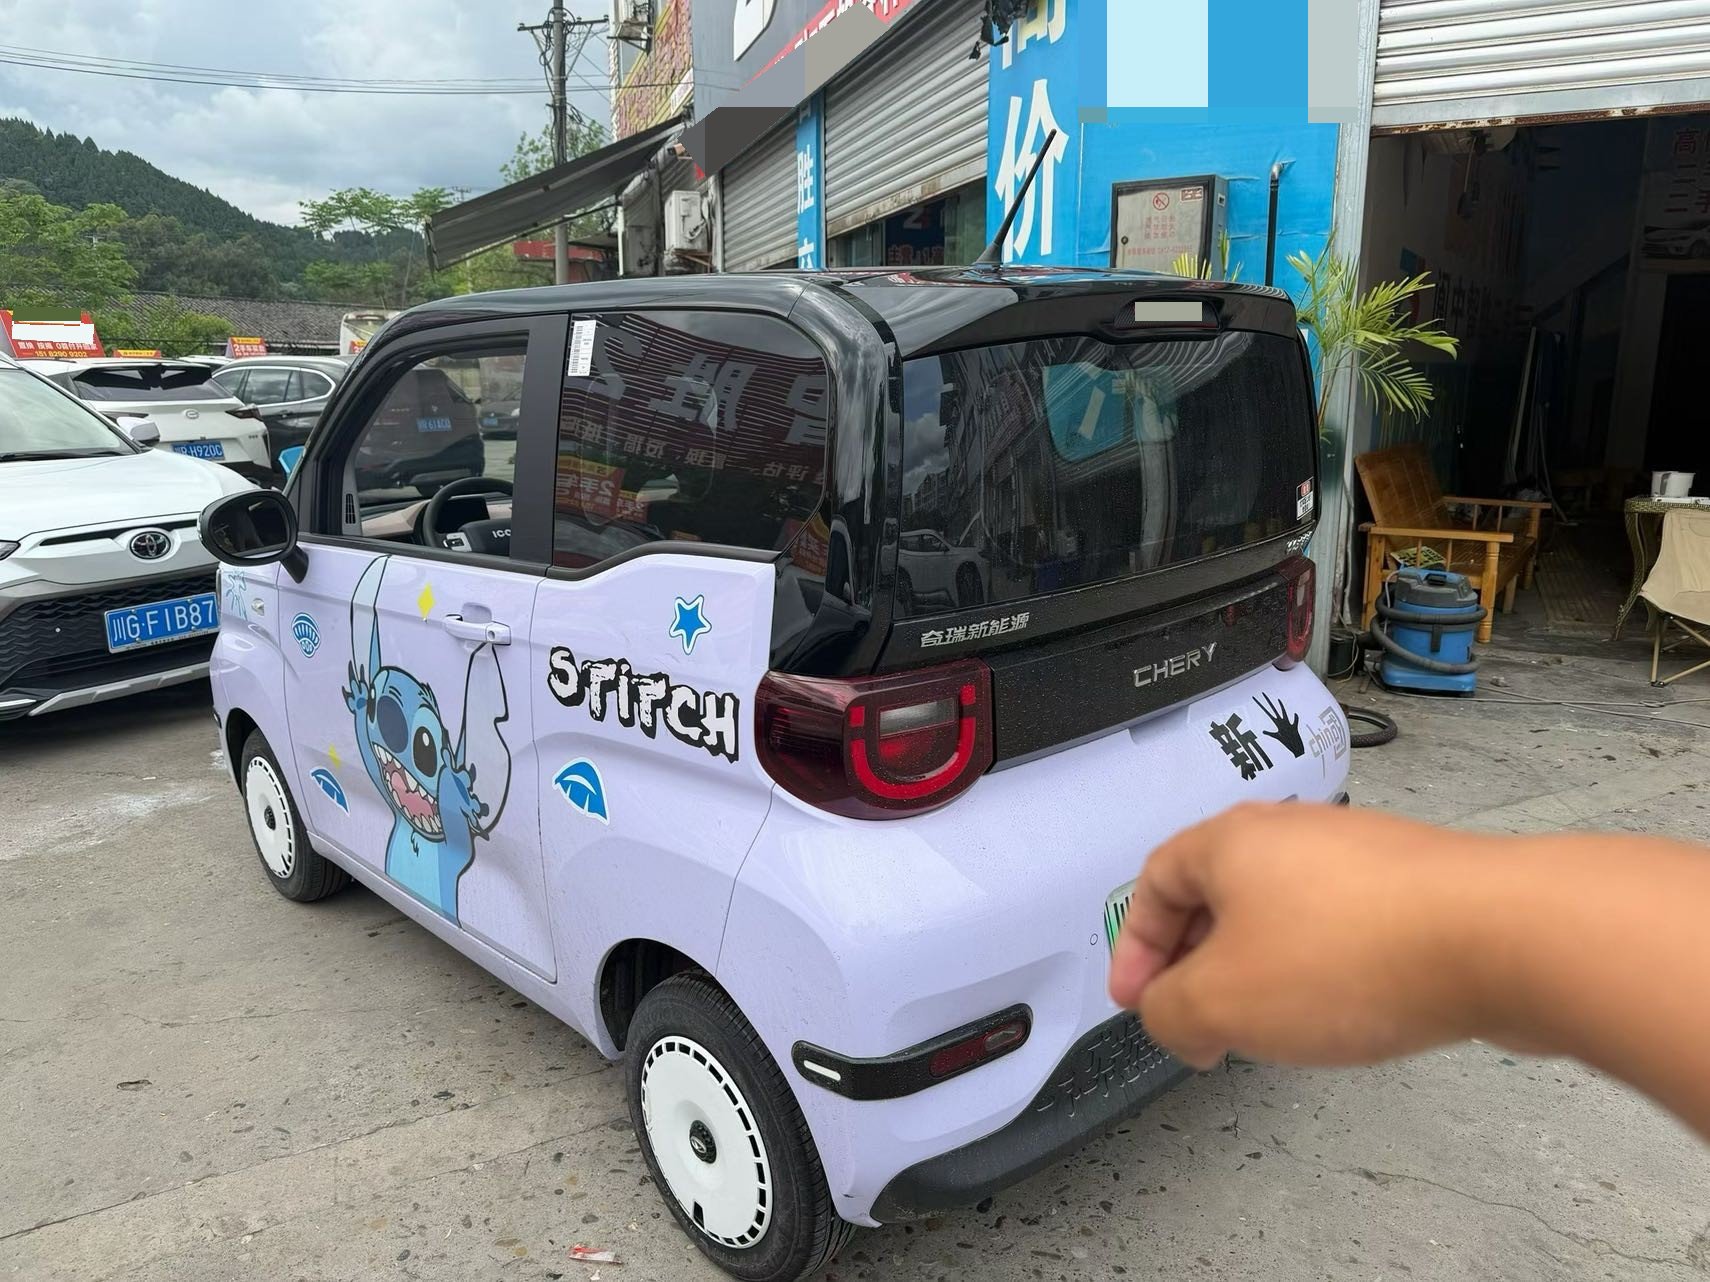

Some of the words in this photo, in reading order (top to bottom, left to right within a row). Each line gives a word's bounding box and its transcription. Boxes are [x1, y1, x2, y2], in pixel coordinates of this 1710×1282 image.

[920, 611, 1030, 648] 奇瑞新能源
[1133, 641, 1218, 688] CHERY
[1208, 712, 1275, 781] 新
